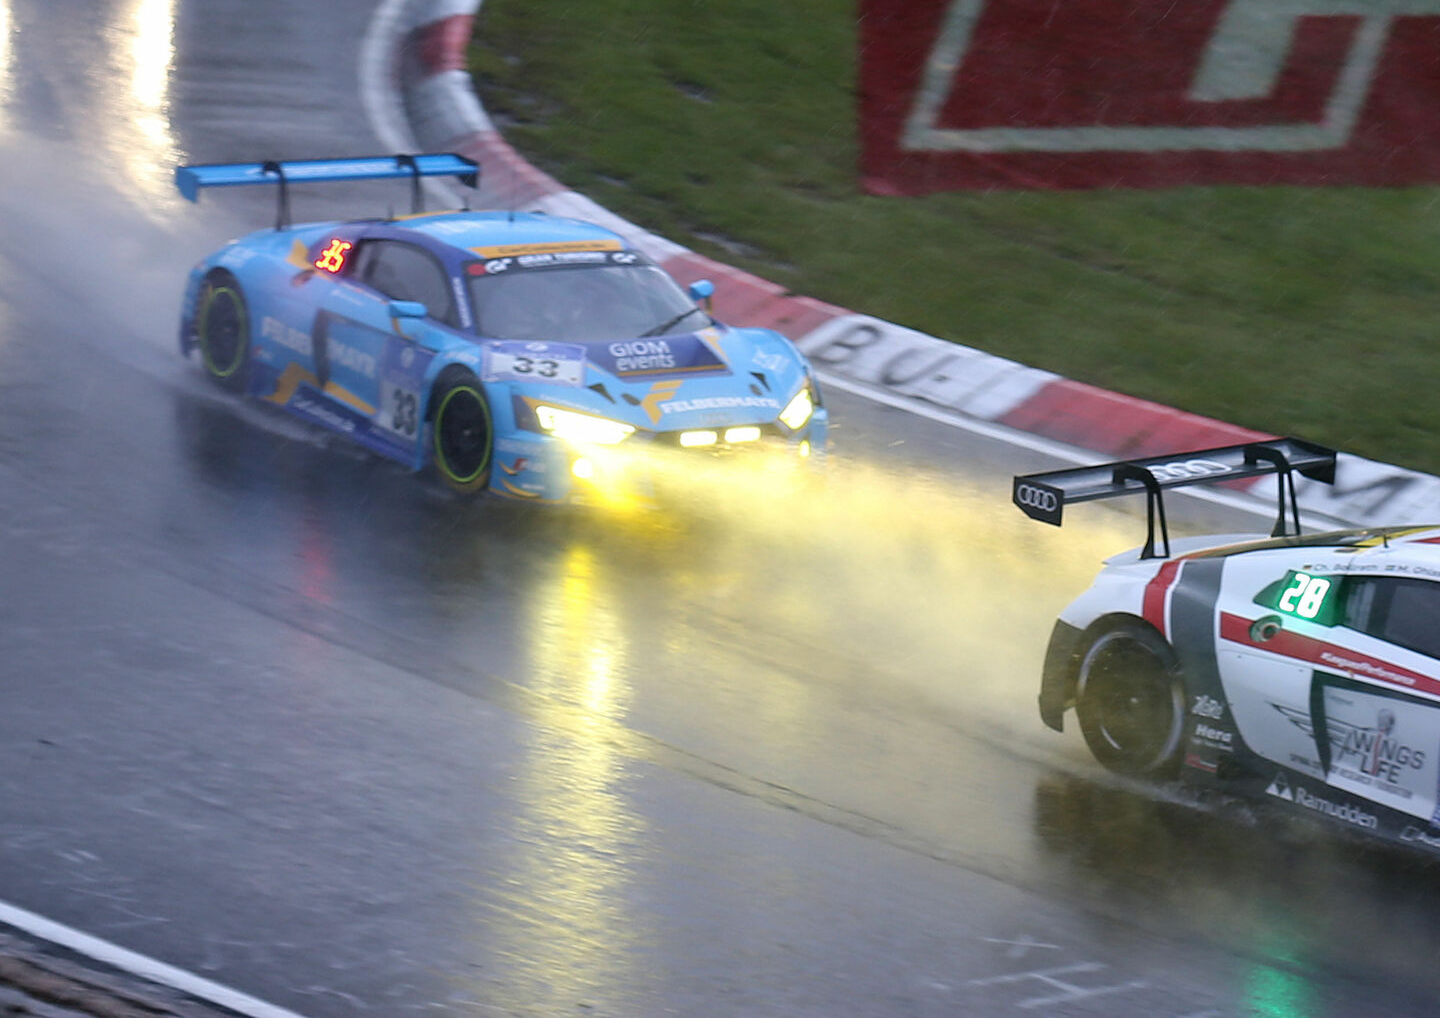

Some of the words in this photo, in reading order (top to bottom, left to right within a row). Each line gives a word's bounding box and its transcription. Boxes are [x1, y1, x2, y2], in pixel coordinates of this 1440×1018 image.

[609, 341, 671, 358] GIOM
[616, 353, 675, 371] events
[513, 357, 558, 378] 33
[1280, 573, 1330, 619] 28
[1354, 730, 1425, 770] WINGS
[1361, 750, 1401, 784] LIFE
[1296, 786, 1377, 830] Ramudden
